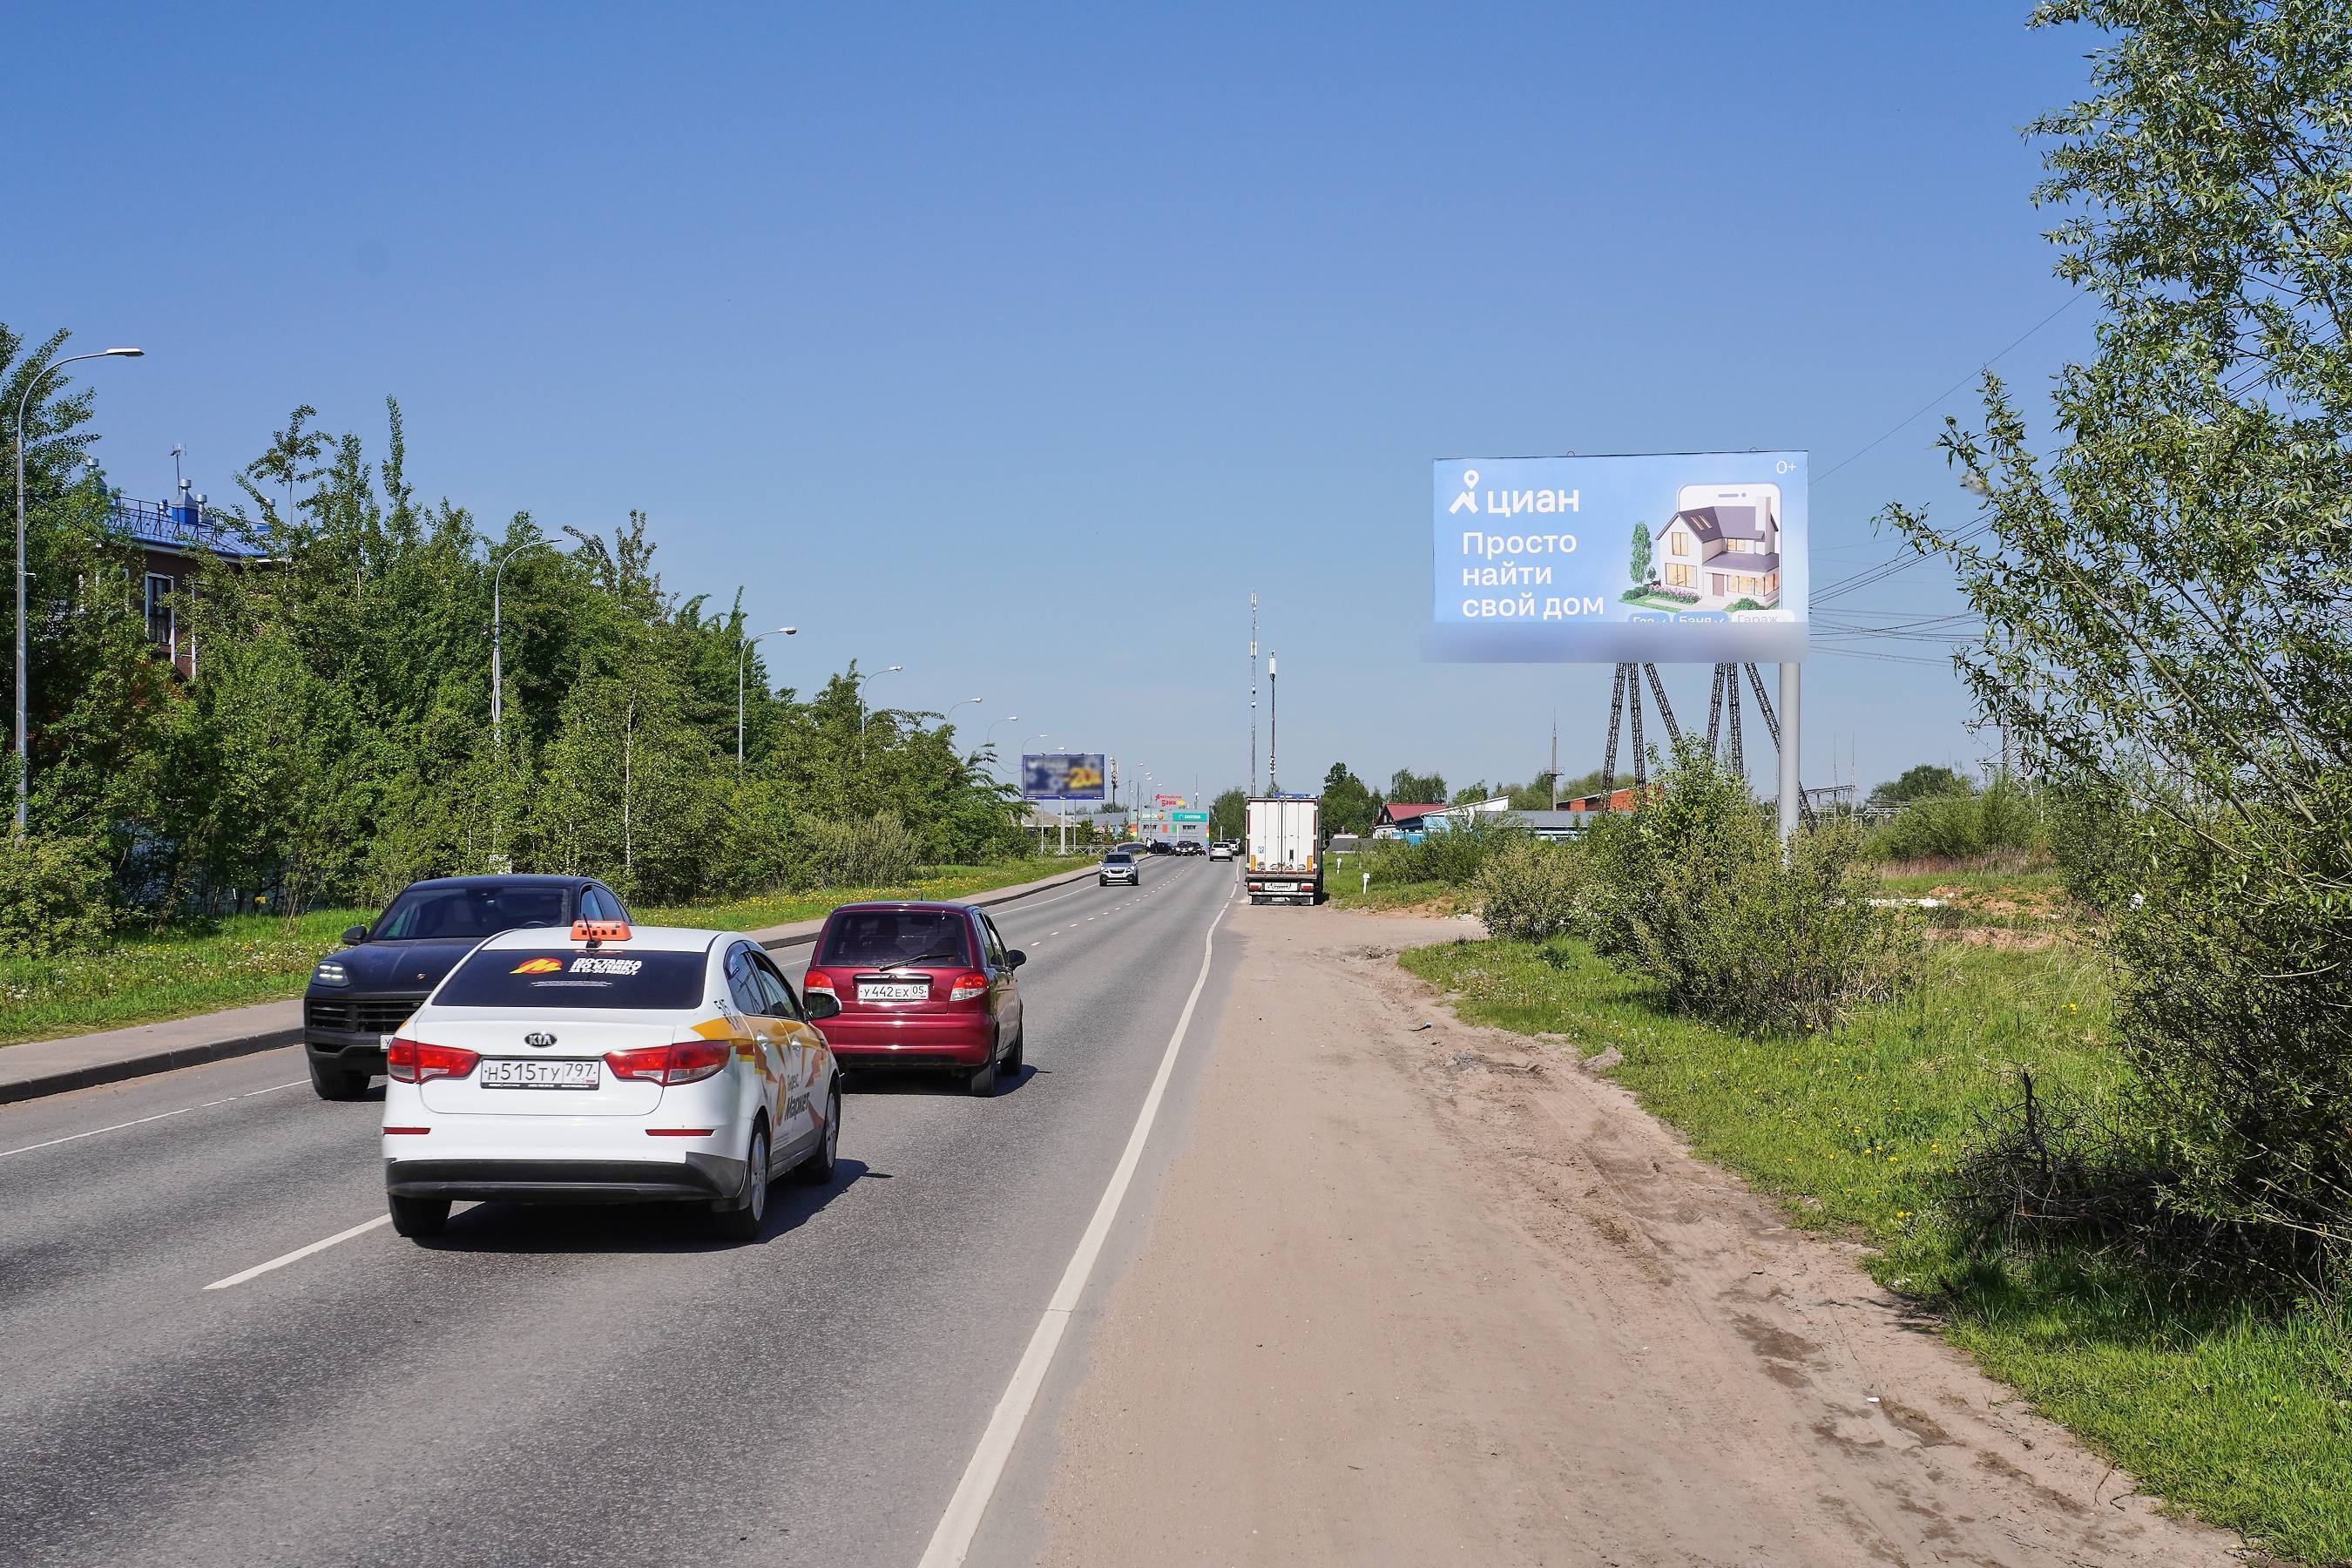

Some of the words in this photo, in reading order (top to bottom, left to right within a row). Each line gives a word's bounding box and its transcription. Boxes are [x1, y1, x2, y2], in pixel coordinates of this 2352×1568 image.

[1776, 459, 1797, 475] 0+
[1486, 489, 1579, 517] циан
[1463, 532, 1578, 560] Просто
[1463, 561, 1552, 586] найти
[1463, 592, 1535, 618] свой
[1543, 597, 1604, 620] дом
[912, 985, 924, 995] 05
[529, 1034, 552, 1045] KIA
[565, 1064, 593, 1077] 797
